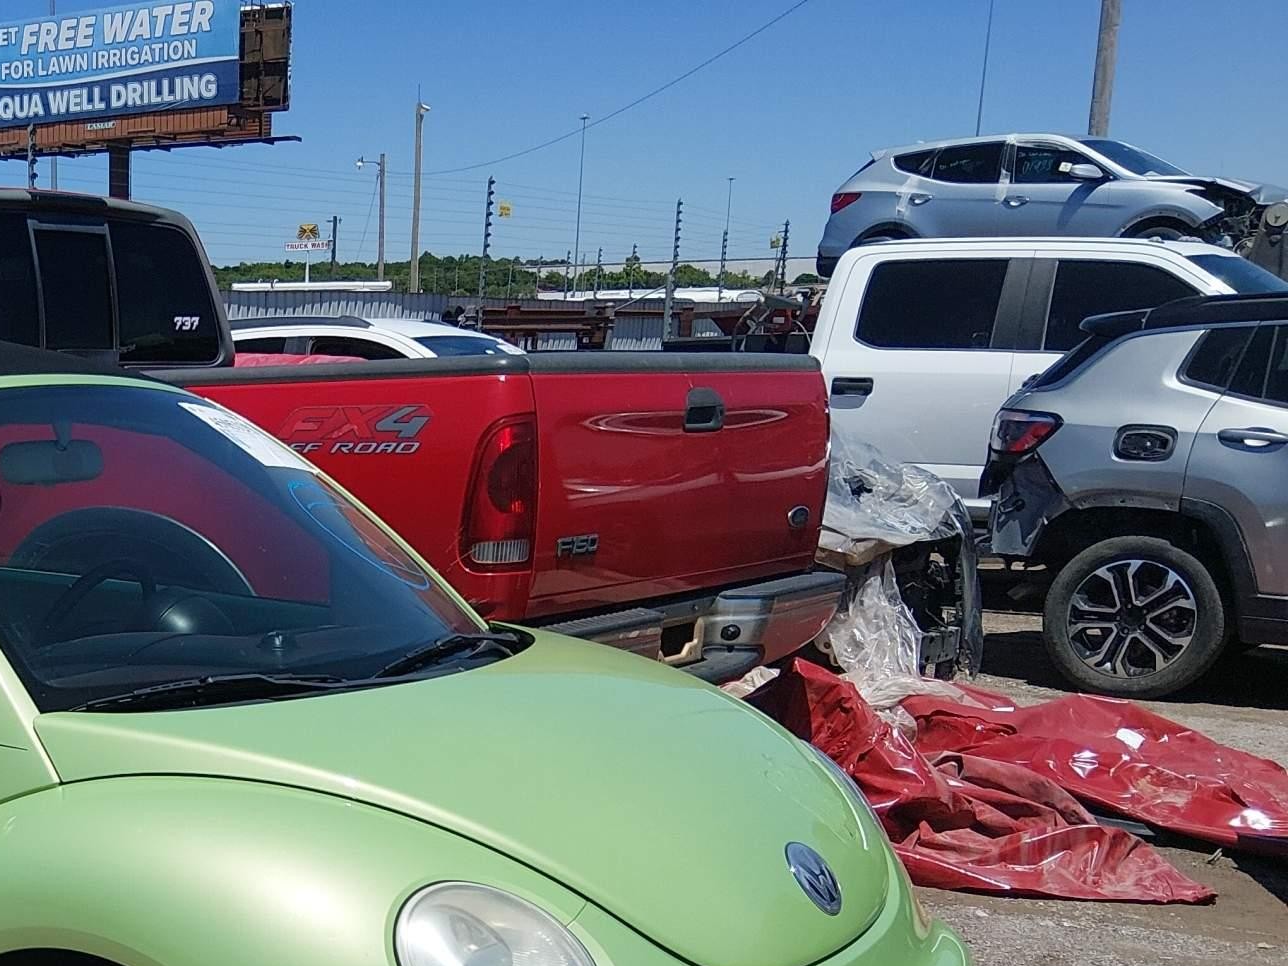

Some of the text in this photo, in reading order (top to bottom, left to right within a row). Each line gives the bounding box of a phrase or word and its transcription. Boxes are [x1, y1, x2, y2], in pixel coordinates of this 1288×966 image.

[20, 15, 96, 55] FREE
[103, 0, 214, 44] WATER
[1, 38, 197, 80] FOR LAWN IRRIGATION
[47, 85, 106, 116] WELL
[110, 73, 217, 109] DRILLING
[174, 316, 200, 330] 737
[278, 405, 431, 440] FX4
[288, 442, 421, 455] FF ROAD
